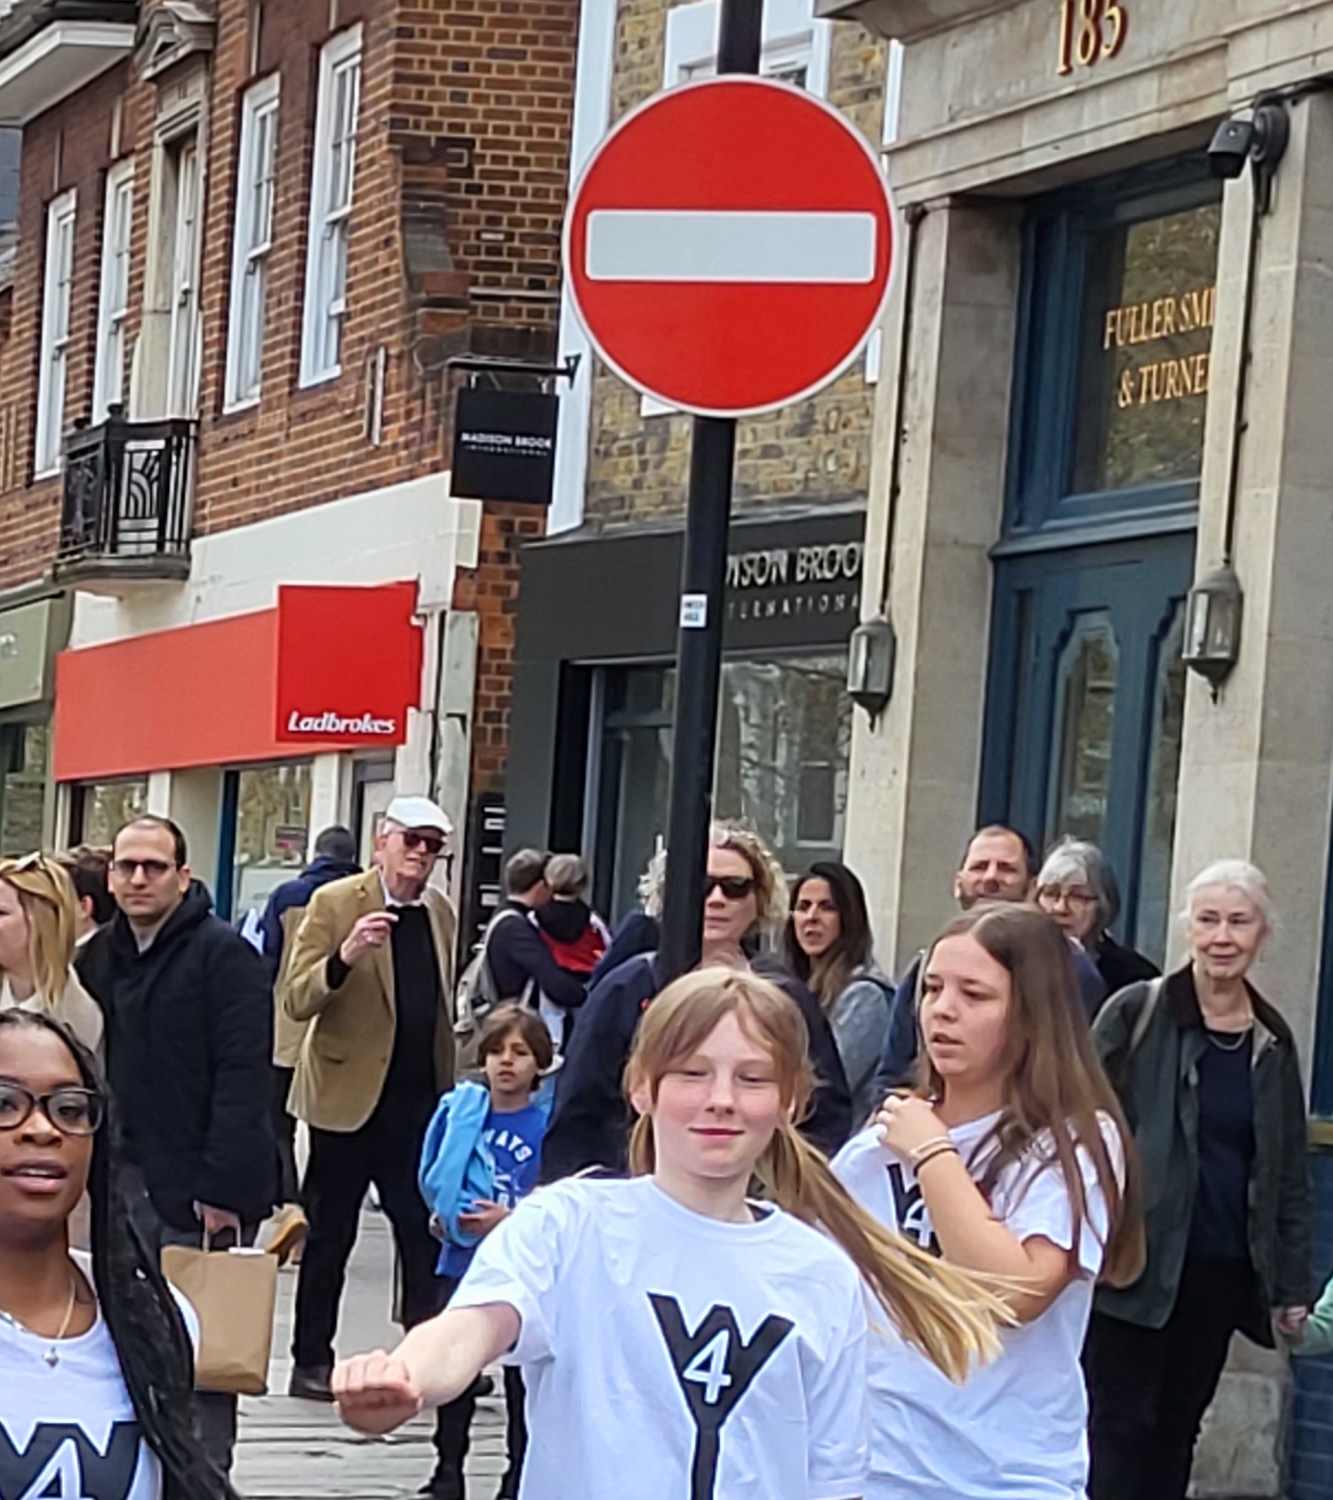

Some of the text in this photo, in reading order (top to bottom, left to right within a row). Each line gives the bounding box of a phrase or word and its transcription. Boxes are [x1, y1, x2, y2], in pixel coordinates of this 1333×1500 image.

[1056, 0, 1127, 75] 185
[1103, 297, 1175, 350] FULLER
[1117, 353, 1210, 408] & TURNE
[796, 541, 862, 582] BROO
[288, 710, 396, 734] Ladbrokes
